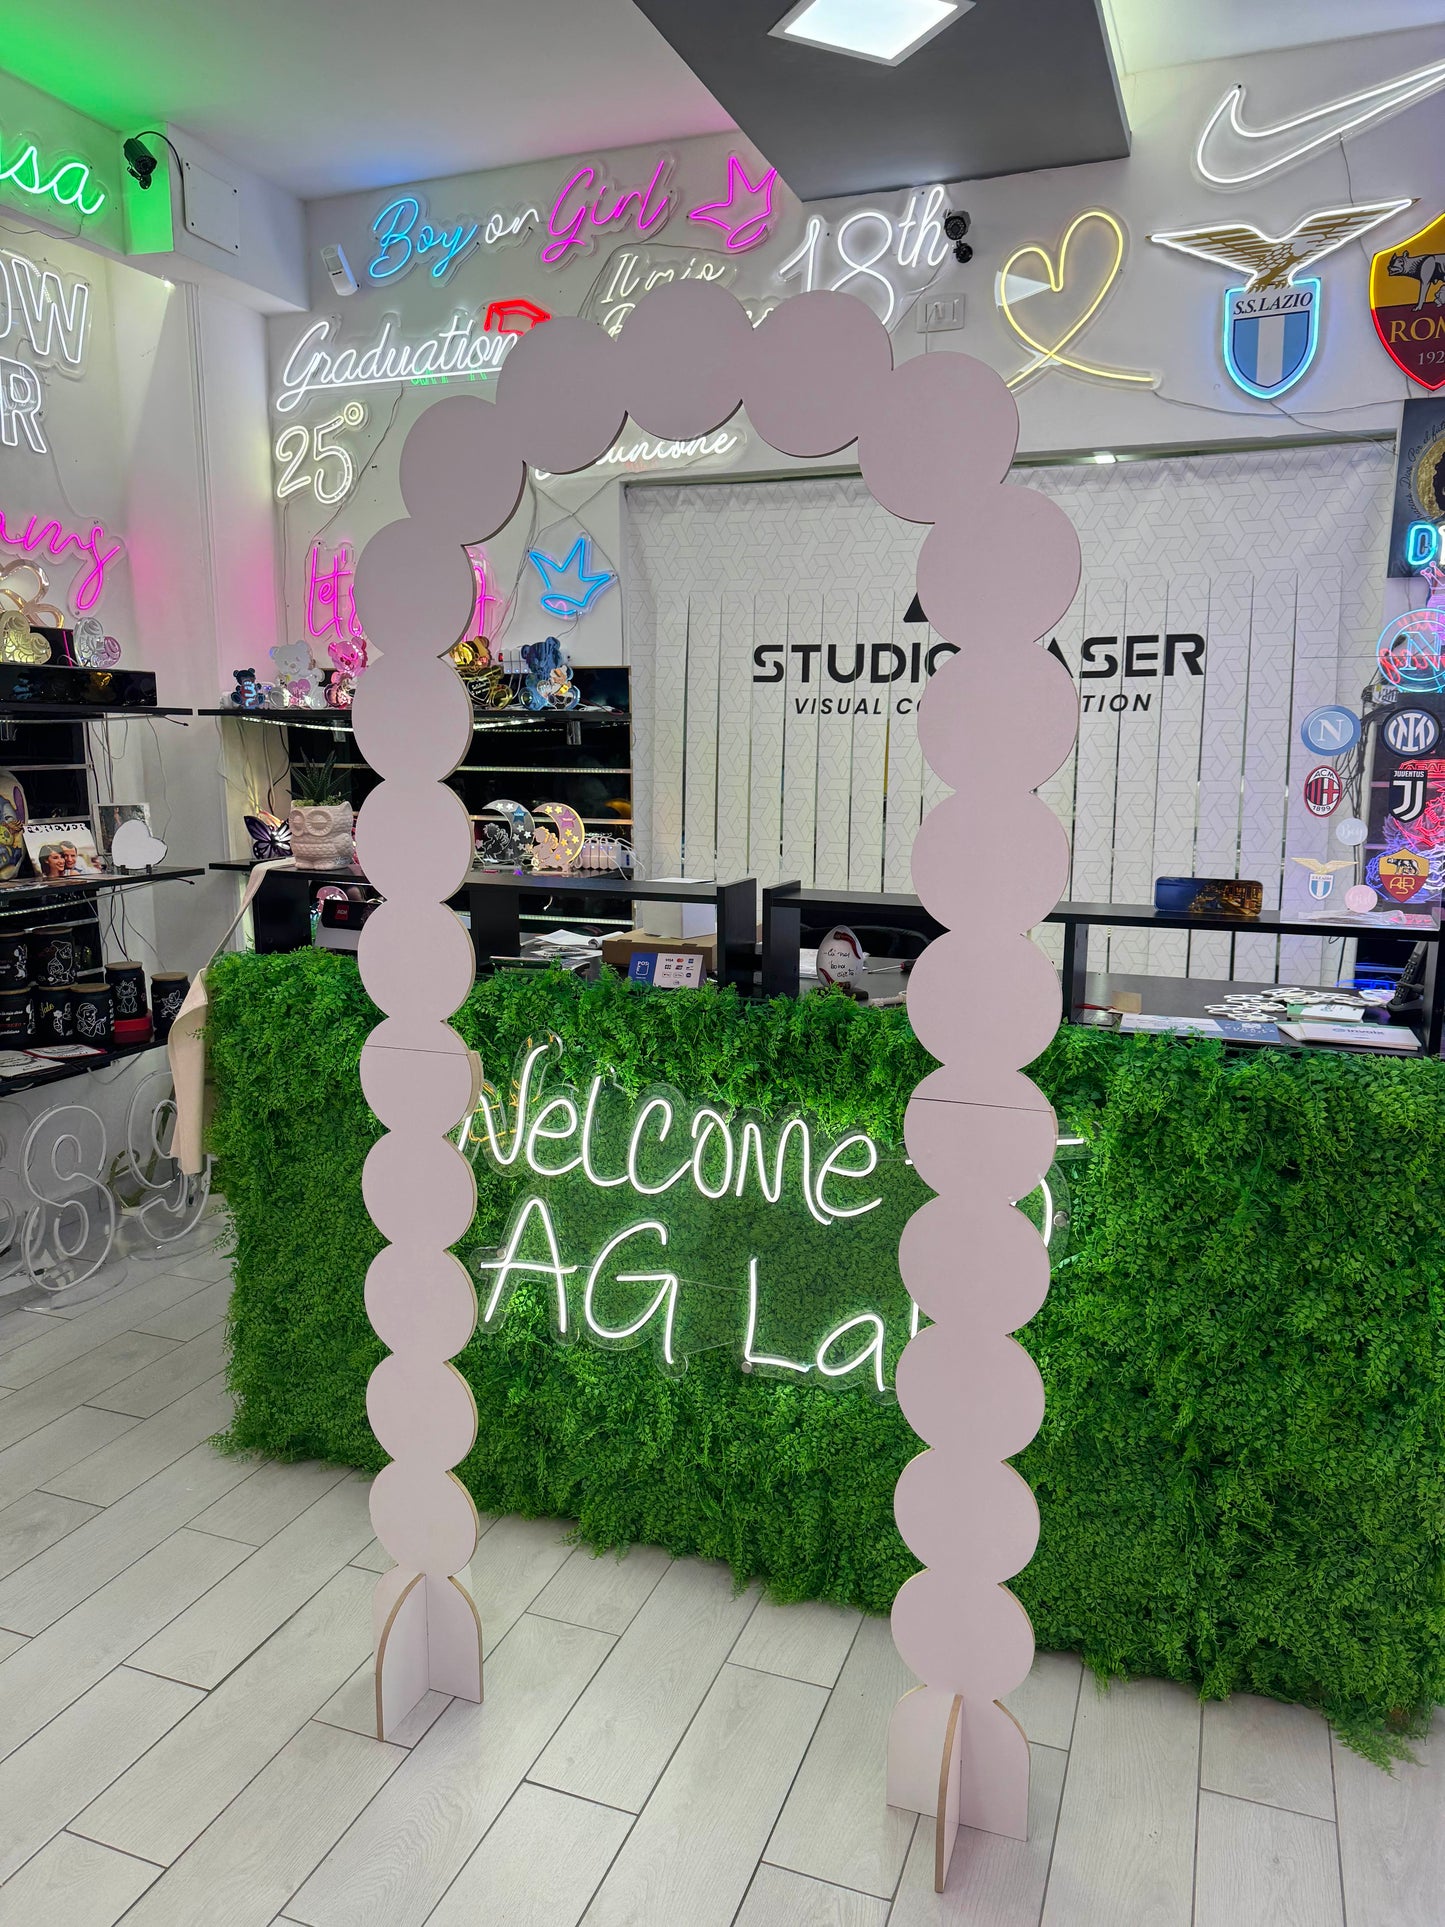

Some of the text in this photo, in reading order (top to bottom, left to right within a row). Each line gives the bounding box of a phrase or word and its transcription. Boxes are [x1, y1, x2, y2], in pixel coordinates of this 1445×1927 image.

[369, 197, 479, 279] Boy
[541, 160, 669, 263] Girl
[778, 183, 949, 326] 18th
[276, 315, 519, 412] Graduation
[794, 697, 882, 715] VISUAL
[1312, 804, 1331, 812] 1899
[1313, 768, 1335, 779] ACM
[1393, 770, 1425, 778] JUVENTUS
[458, 1044, 883, 1225] Welcome
[480, 1197, 676, 1366] AG
